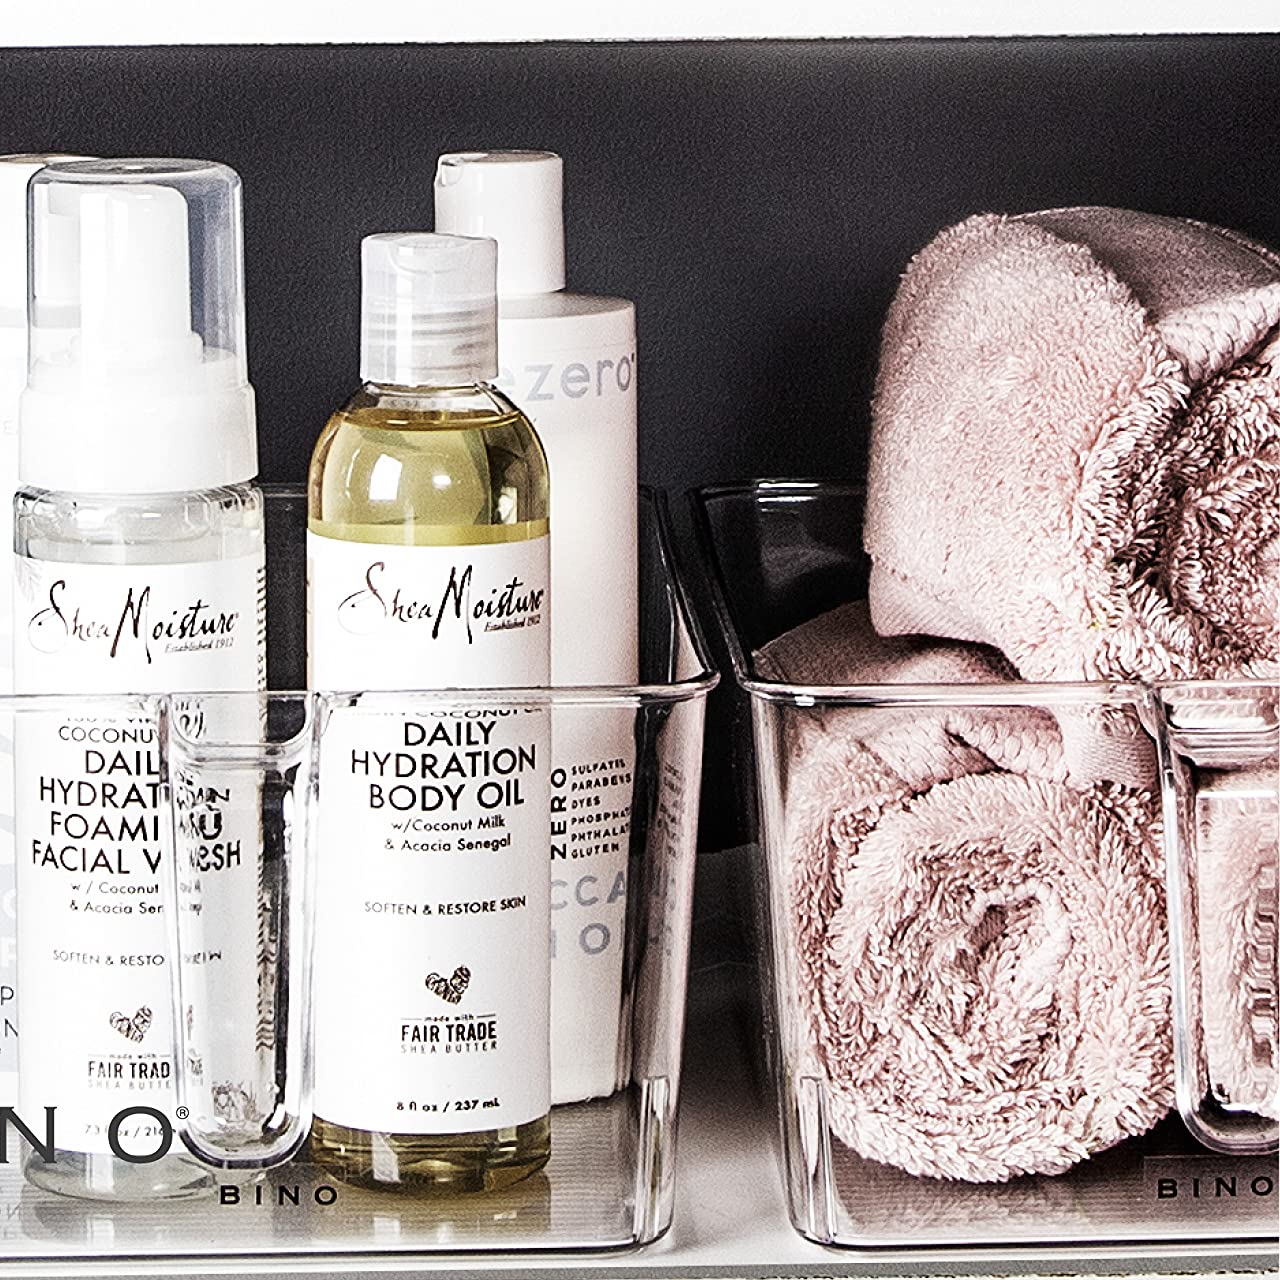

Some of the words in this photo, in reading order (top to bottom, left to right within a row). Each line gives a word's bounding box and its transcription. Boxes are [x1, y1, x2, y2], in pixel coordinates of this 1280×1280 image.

[58, 725, 156, 744] COCONU
[403, 721, 497, 747] DAILY
[85, 750, 161, 776] DAIL
[351, 744, 537, 780] HYDRATION
[571, 758, 626, 776] SULFATES
[571, 772, 633, 792] PARABENS
[369, 782, 466, 811] BODY
[477, 779, 525, 810] OIL
[571, 795, 601, 810] DYES
[477, 814, 506, 830] Milk
[550, 768, 567, 860] ZERO
[384, 838, 395, 851] &
[401, 839, 452, 853] Acacia
[456, 834, 512, 853] Senegal
[571, 842, 620, 860] GLUTEN
[33, 839, 131, 875] FACIAL
[98, 881, 160, 894] Coconut
[83, 901, 133, 915] Acacia
[364, 900, 417, 915] SOFTEN
[423, 904, 432, 915] &
[438, 899, 497, 916] RESTORE
[500, 896, 527, 911] SKIN
[52, 949, 100, 965] SOFTEN
[105, 955, 114, 966] &
[401, 1024, 440, 1042] FAIR
[445, 1021, 497, 1042] TRADE
[401, 1044, 437, 1054] SHEA
[445, 1040, 497, 1054] BUTTER
[88, 1060, 124, 1079] FAIR
[129, 1061, 170, 1080] TRAD
[88, 1079, 121, 1089] SHEA
[396, 1101, 405, 1111] 8
[455, 1099, 479, 1111] 237
[220, 1184, 338, 1206] BINO
[1157, 1175, 1274, 1200] BINO
